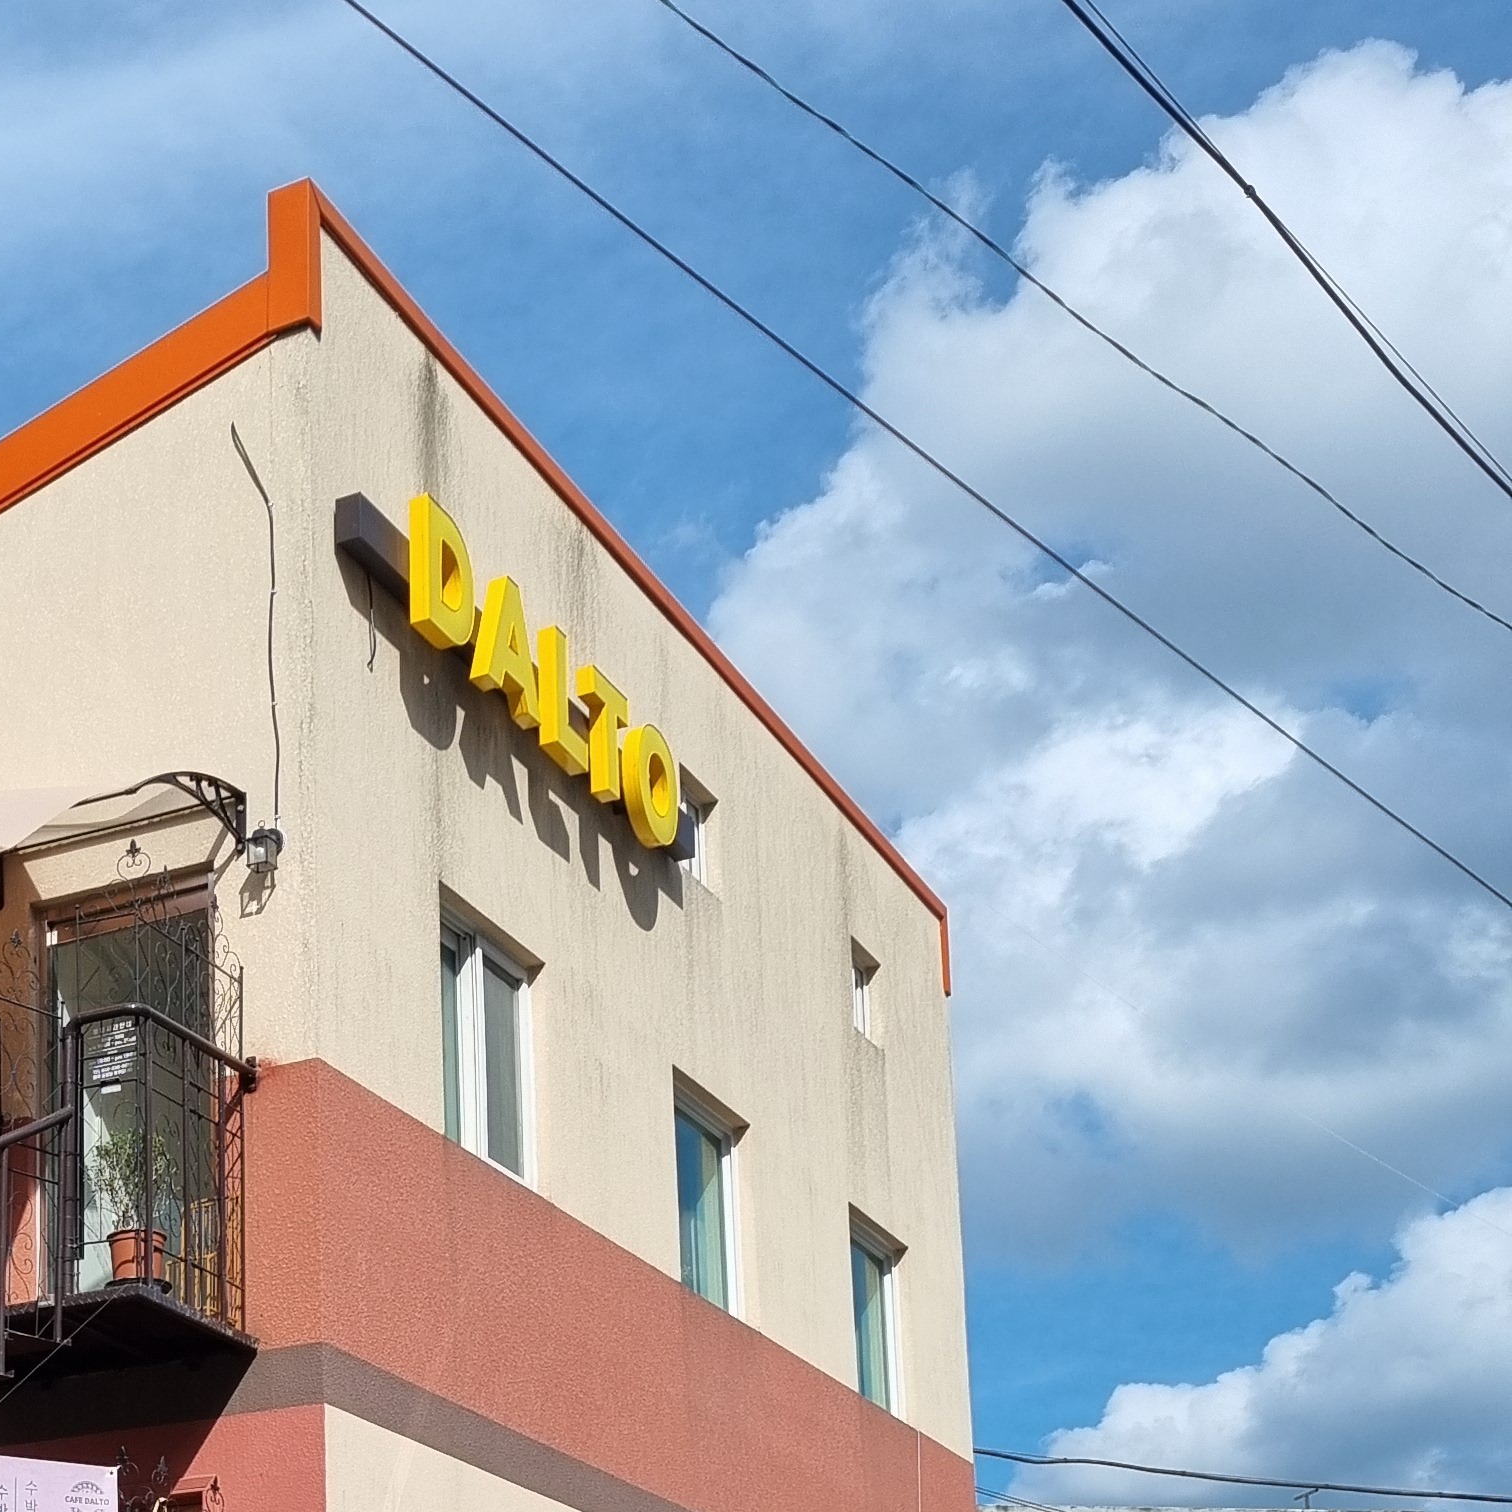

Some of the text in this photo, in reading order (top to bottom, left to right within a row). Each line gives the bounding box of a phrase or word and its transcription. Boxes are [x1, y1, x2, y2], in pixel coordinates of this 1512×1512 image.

[409, 492, 678, 849] DALTO
[65, 1495, 110, 1505] CAFE DALTO
